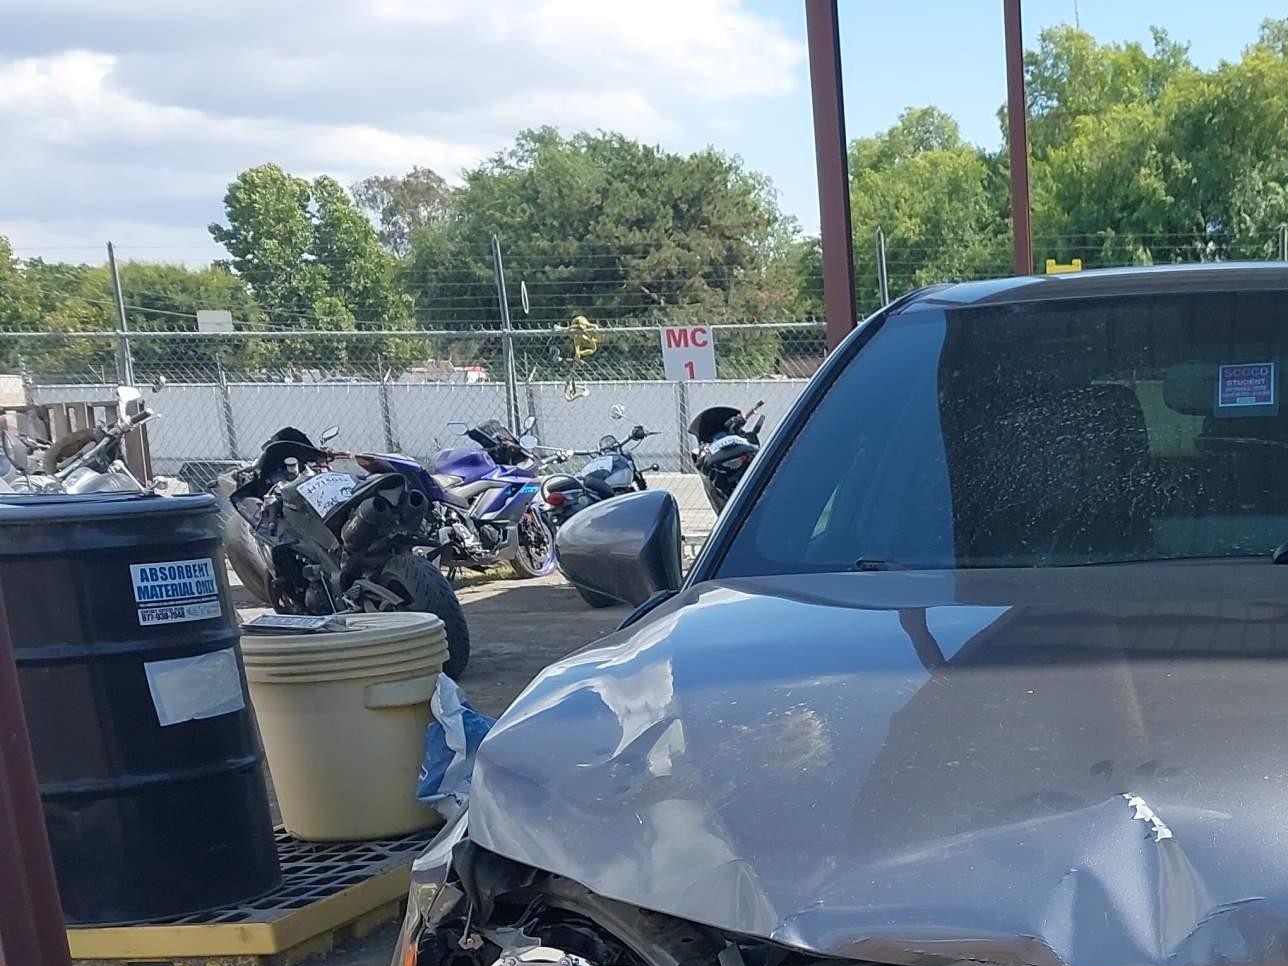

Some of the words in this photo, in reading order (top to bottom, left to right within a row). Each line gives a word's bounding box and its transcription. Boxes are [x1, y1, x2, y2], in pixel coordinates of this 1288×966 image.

[665, 327, 708, 348] MC
[684, 361, 695, 380] 1
[139, 562, 210, 583] ABSORBENT
[136, 581, 195, 601] MATERIAL
[195, 579, 216, 596] ONLY
